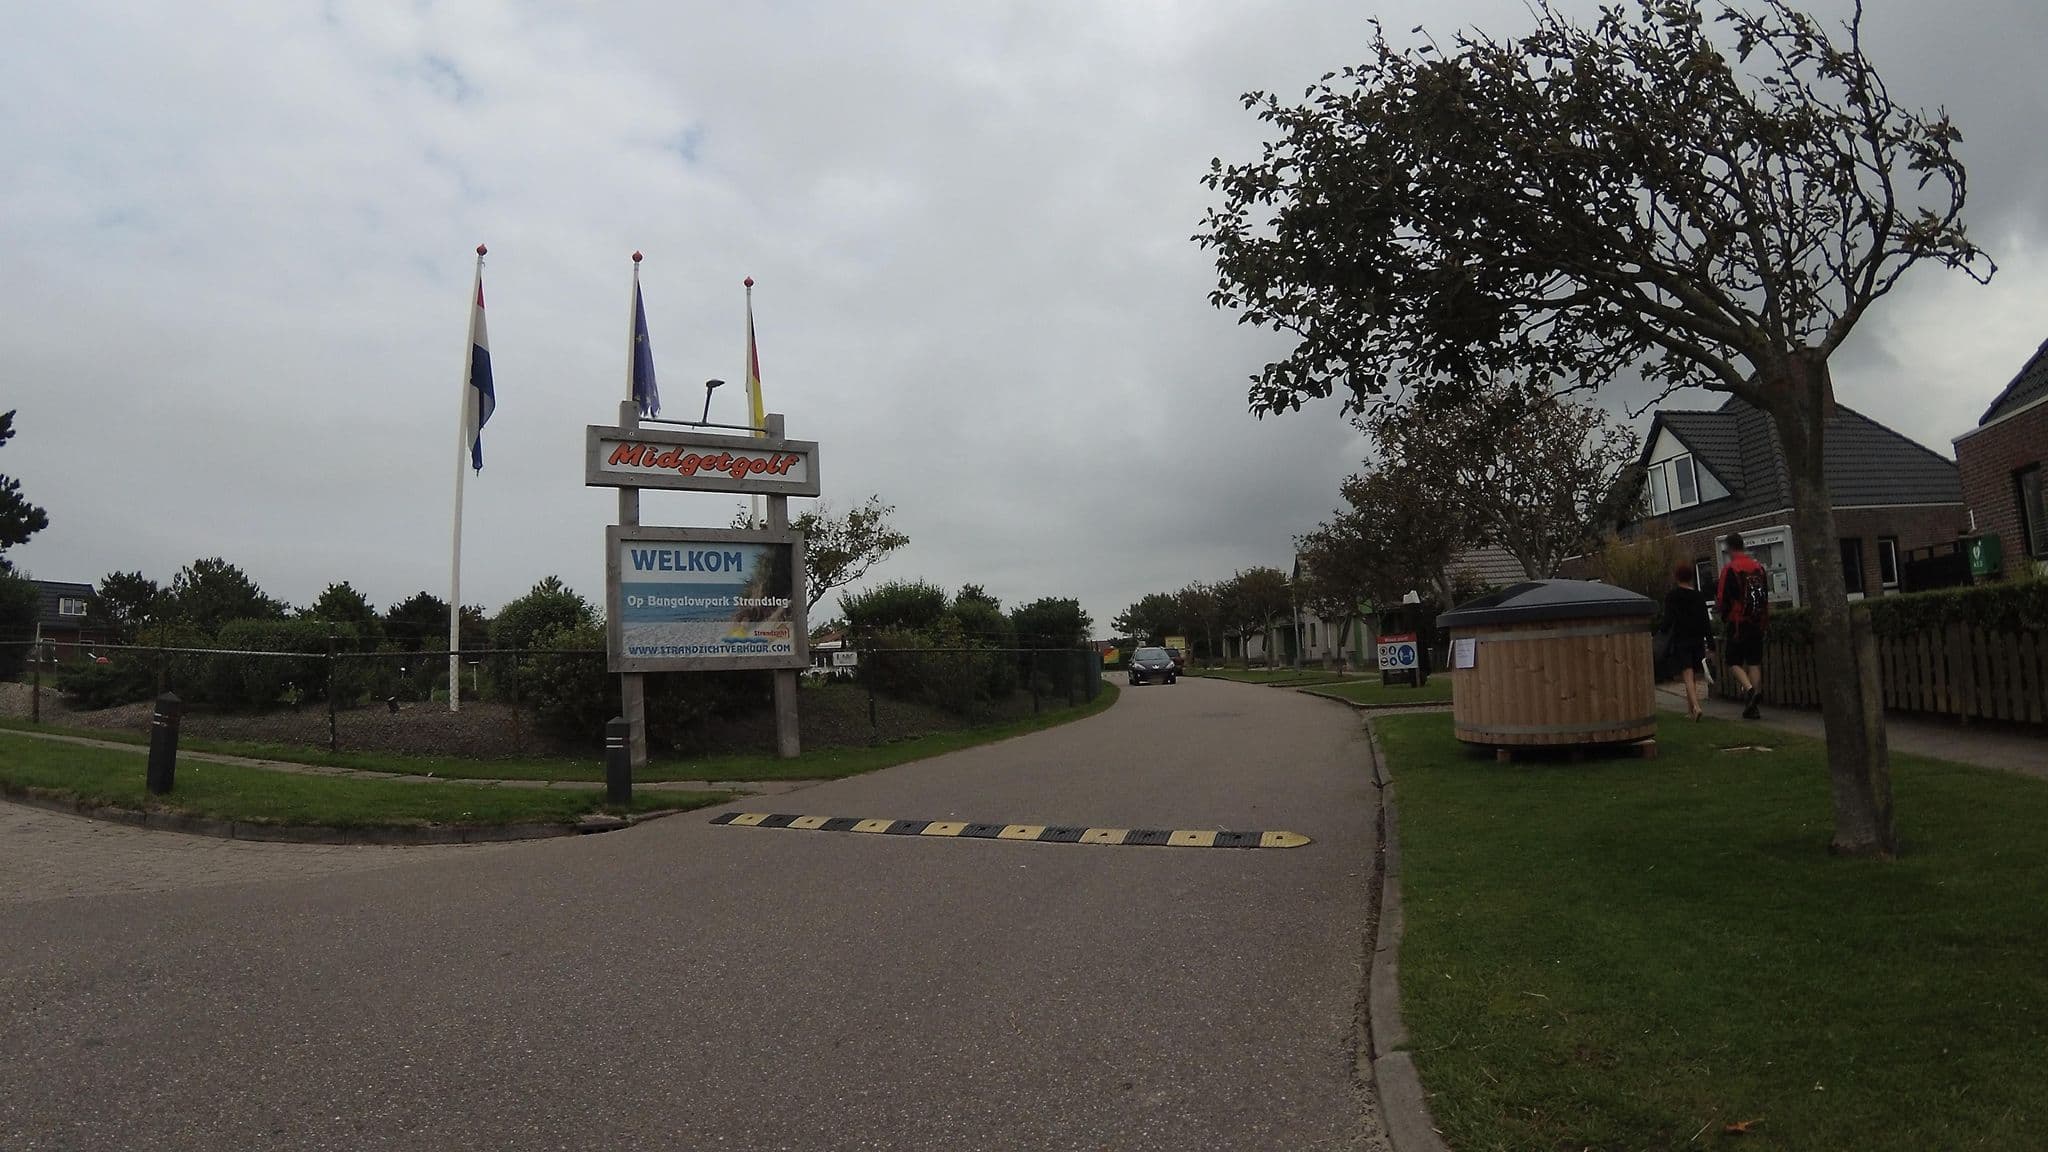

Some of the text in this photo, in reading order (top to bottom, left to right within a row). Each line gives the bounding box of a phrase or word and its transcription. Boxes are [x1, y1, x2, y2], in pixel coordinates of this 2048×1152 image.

[609, 443, 798, 478] Midgetgolf
[631, 550, 743, 572] WELKOM
[627, 595, 790, 609] Op Bungalowpark Strandslag
[628, 644, 791, 655] WWW.STRANDZICHTVERHUUR.COM
